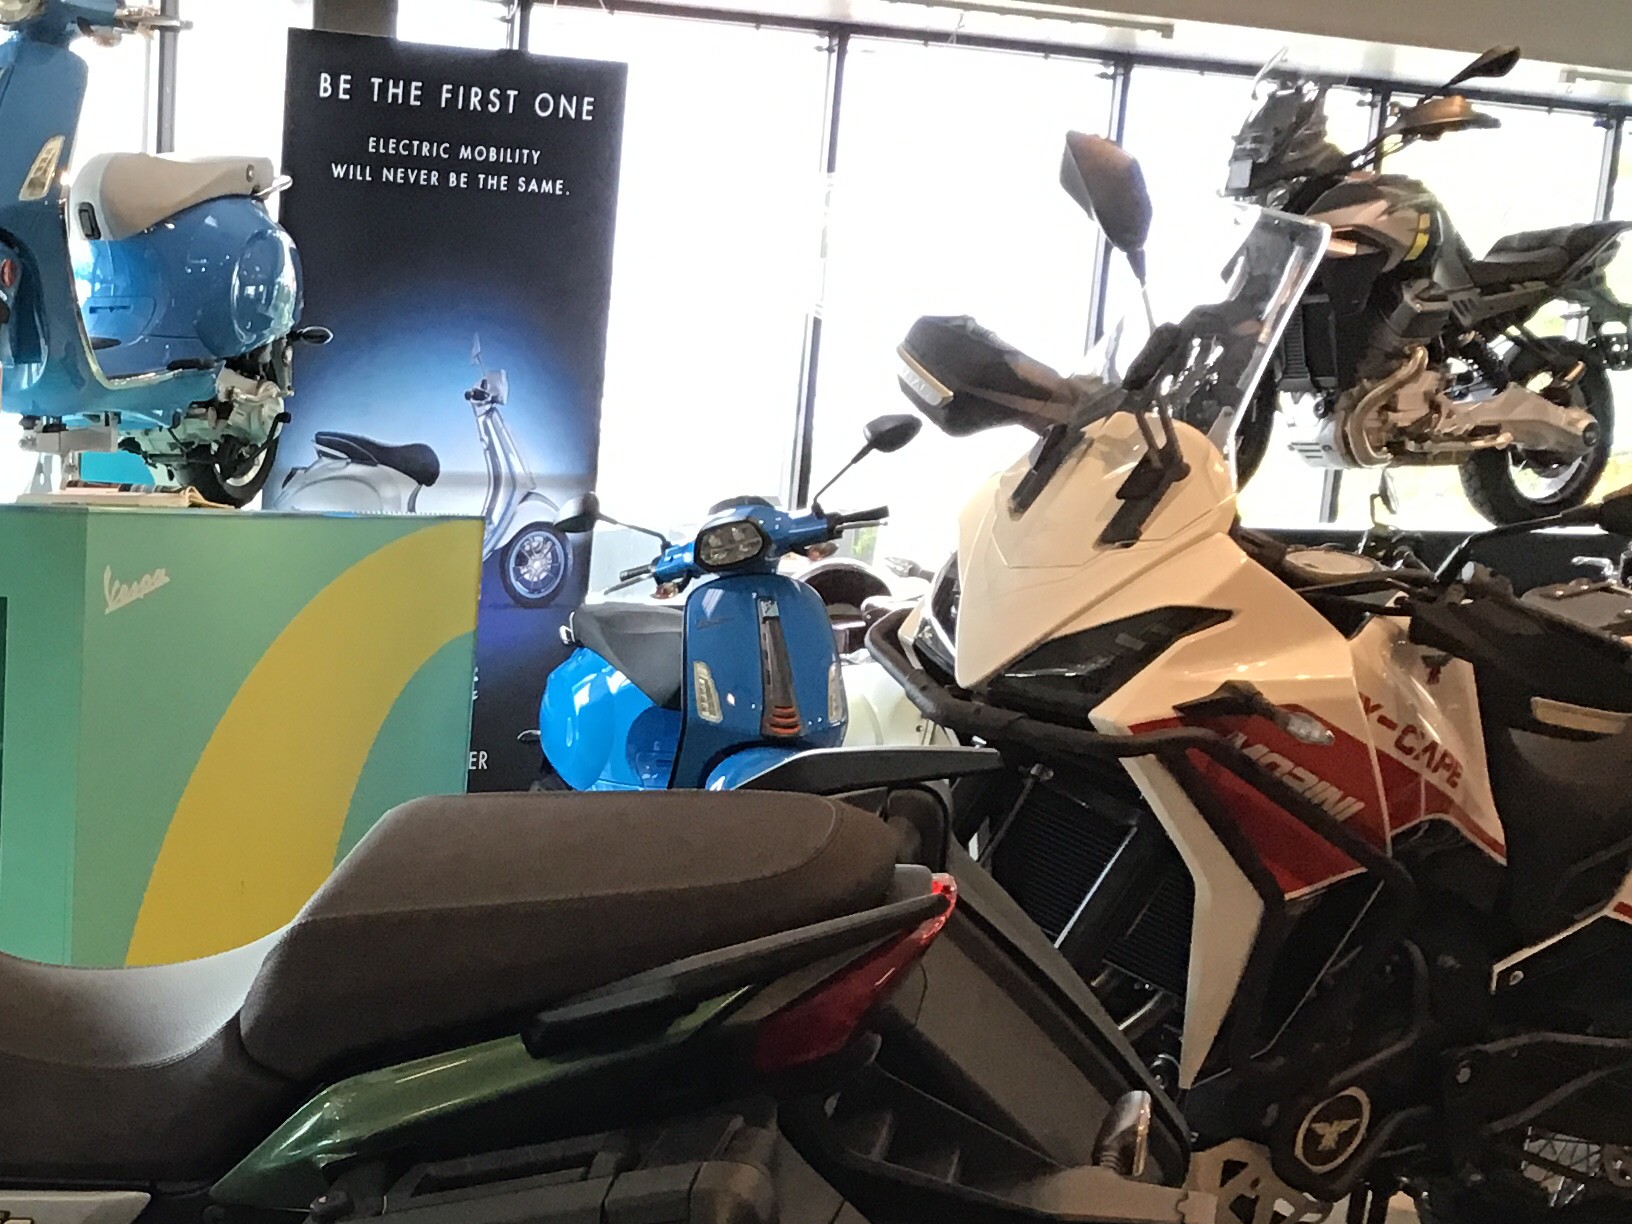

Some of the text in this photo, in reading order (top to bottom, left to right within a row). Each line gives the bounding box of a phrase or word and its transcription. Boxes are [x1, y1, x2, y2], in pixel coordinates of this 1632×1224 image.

[319, 72, 595, 121] BE THE FIRST ONE
[368, 136, 541, 165] ELECTRIC MOBILITY
[331, 162, 570, 196] WILL NEVER BE THE SAME.
[104, 563, 170, 615] Vespa
